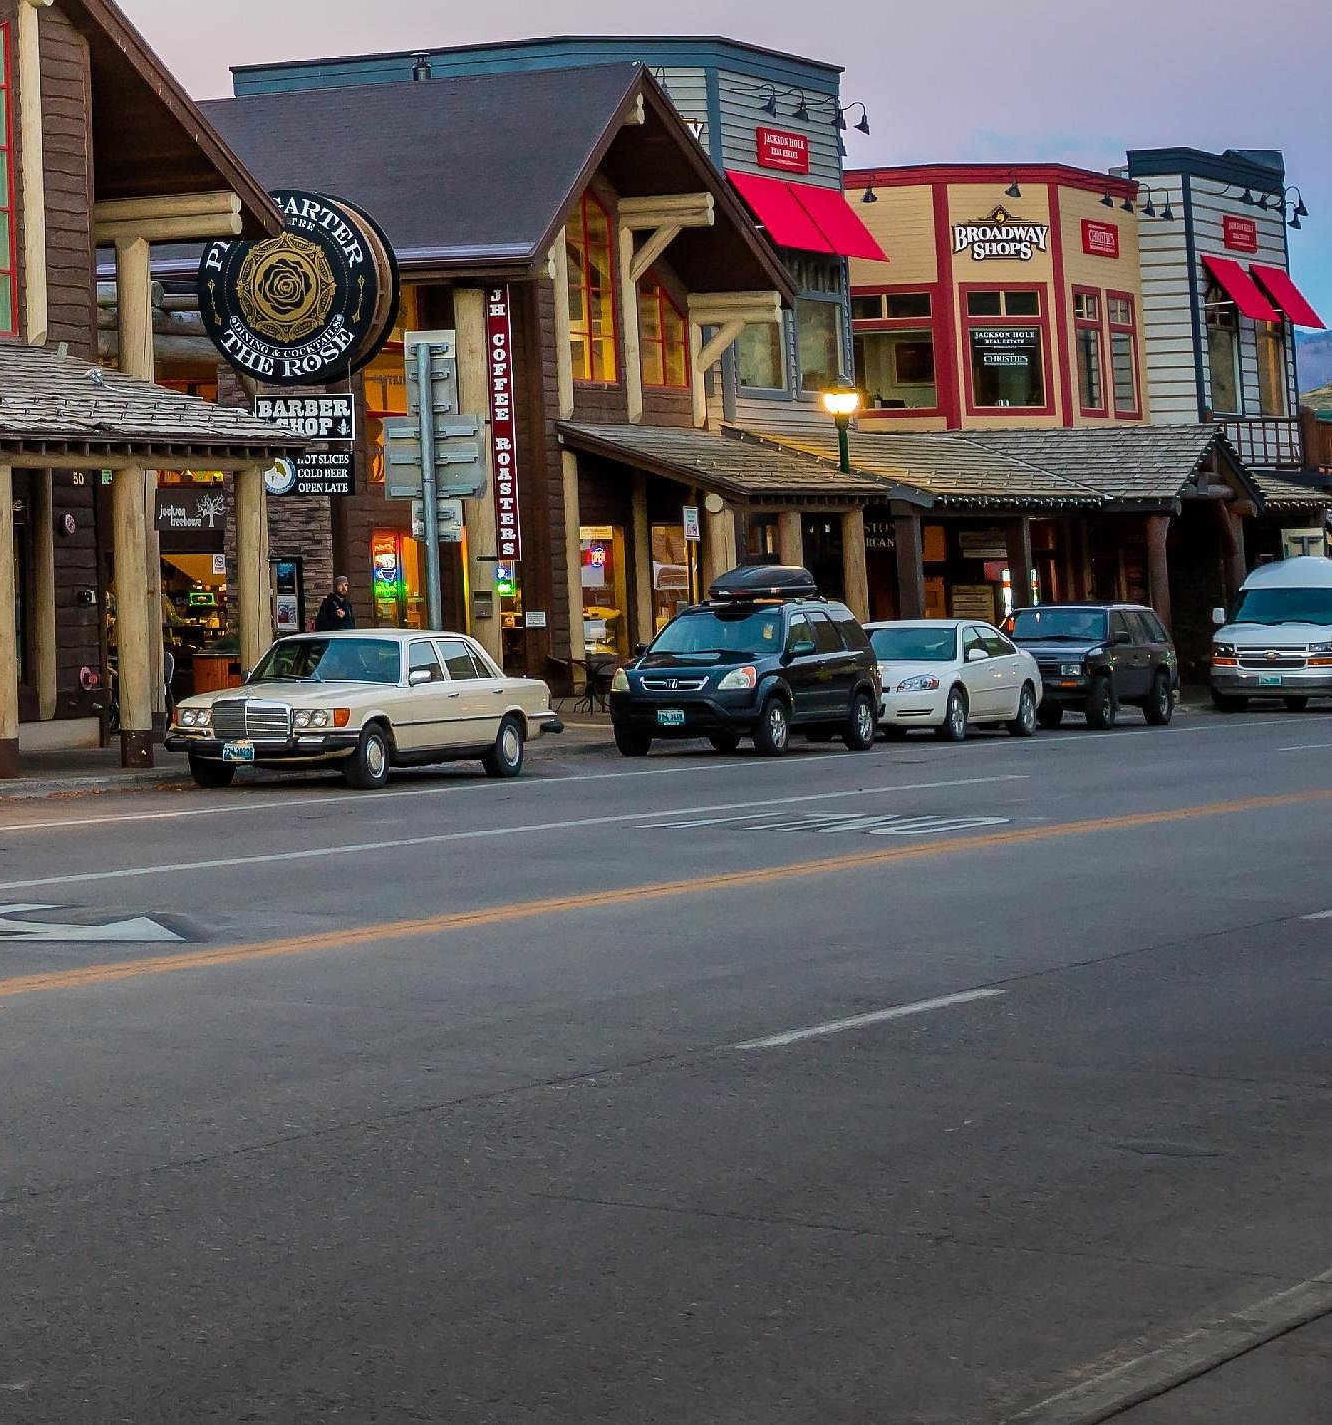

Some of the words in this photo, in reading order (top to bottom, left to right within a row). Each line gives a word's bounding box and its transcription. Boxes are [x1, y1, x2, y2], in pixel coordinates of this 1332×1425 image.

[954, 225, 1048, 254] BROADWAY
[973, 241, 1032, 260] SHOPS
[220, 328, 274, 376] THE
[281, 328, 355, 377] ROSE
[492, 333, 510, 421] COFFEE
[257, 399, 351, 418] BARBER
[319, 454, 350, 464] SLICES
[297, 468, 323, 478] COLD
[324, 468, 348, 478] BEER
[298, 482, 324, 493] OPEN
[324, 482, 349, 493] LATE
[495, 437, 516, 555] ROASTERS
